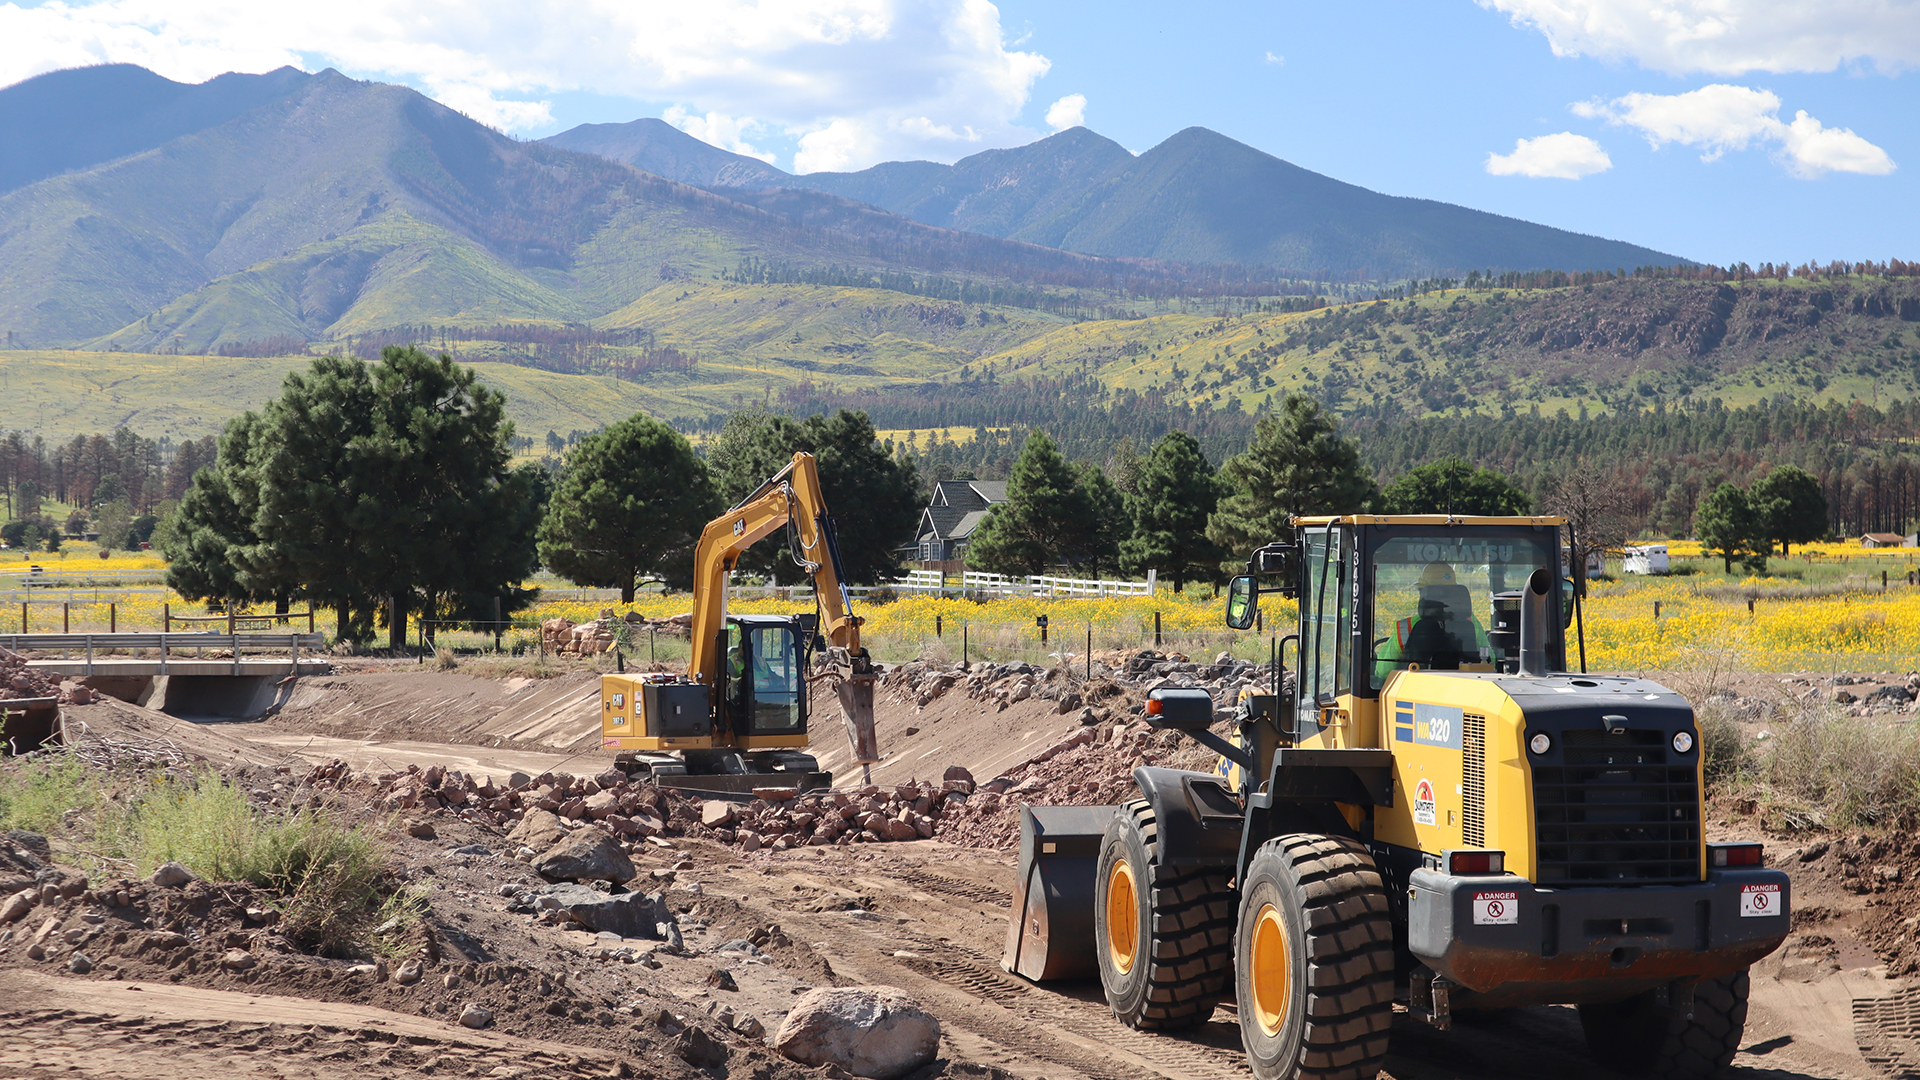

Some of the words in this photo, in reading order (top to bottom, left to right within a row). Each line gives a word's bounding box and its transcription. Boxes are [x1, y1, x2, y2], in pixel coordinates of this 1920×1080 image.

[733, 518, 745, 537] CAT
[1406, 544, 1514, 562] KOMATSU
[612, 693, 623, 707] CAT
[1417, 717, 1451, 743] WA320
[1484, 892, 1516, 900] DANGER
[1750, 884, 1779, 892] DANGER
